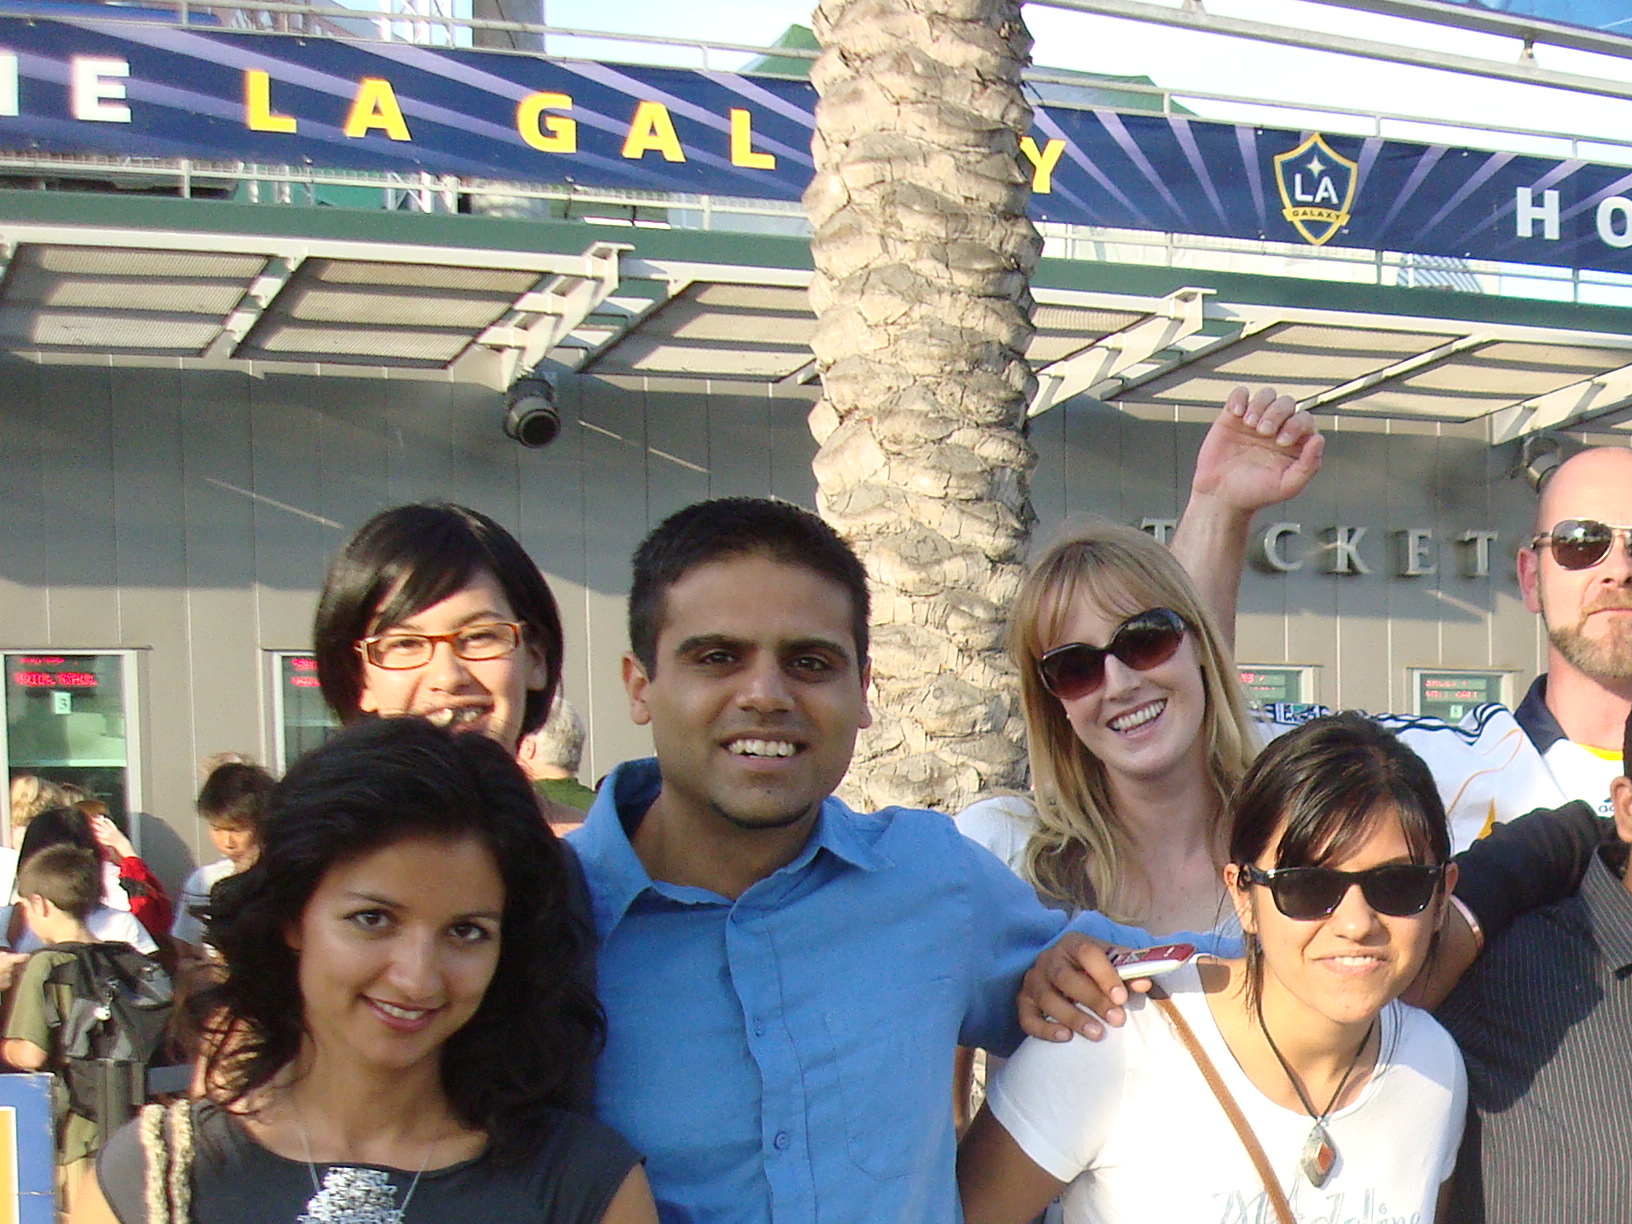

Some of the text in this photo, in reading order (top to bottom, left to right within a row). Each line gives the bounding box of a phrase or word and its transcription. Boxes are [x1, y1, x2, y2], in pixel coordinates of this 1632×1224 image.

[246, 70, 412, 142] LA
[1294, 173, 1340, 205] LA
[1292, 209, 1341, 221] GALAXY
